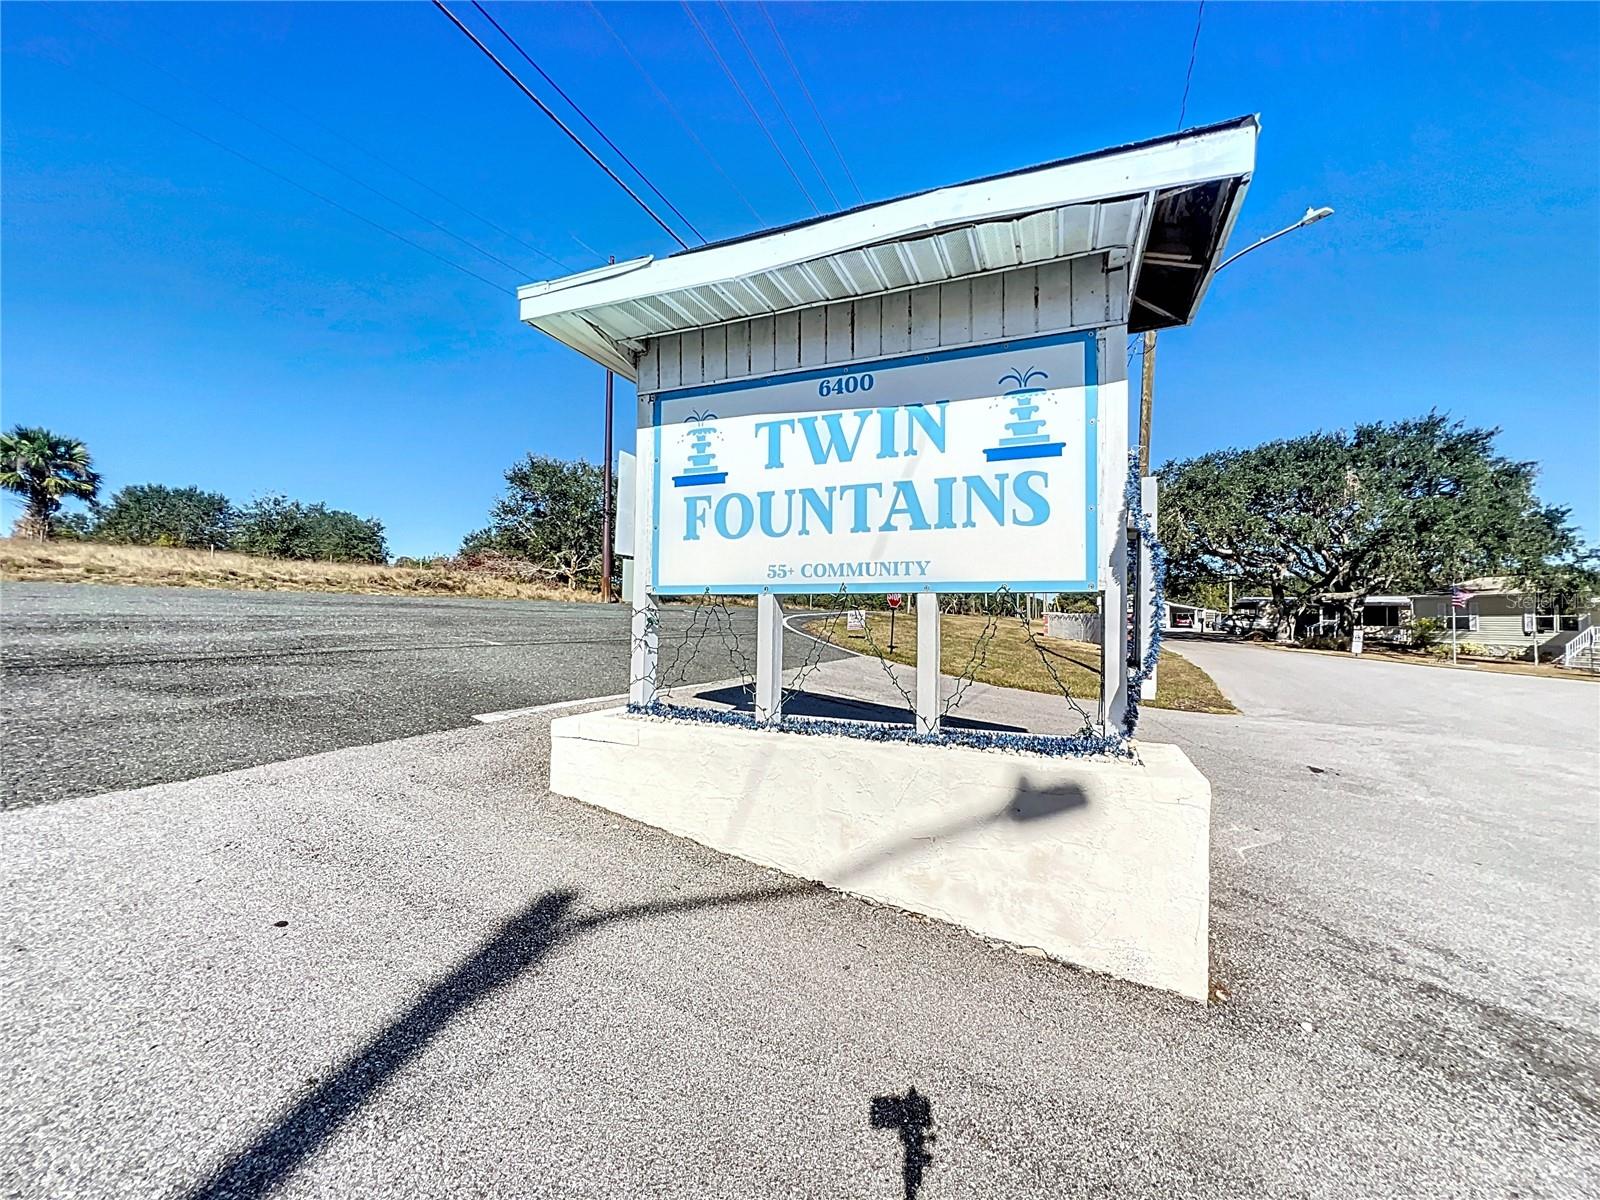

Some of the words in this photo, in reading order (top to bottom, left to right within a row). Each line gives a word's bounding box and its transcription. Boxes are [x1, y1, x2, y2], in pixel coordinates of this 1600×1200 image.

[818, 373, 874, 397] 6400
[754, 400, 950, 469] TWIN
[682, 471, 1050, 541] FOUNTAINS
[767, 563, 795, 579] 55+
[800, 560, 931, 579] COMMUNITY
